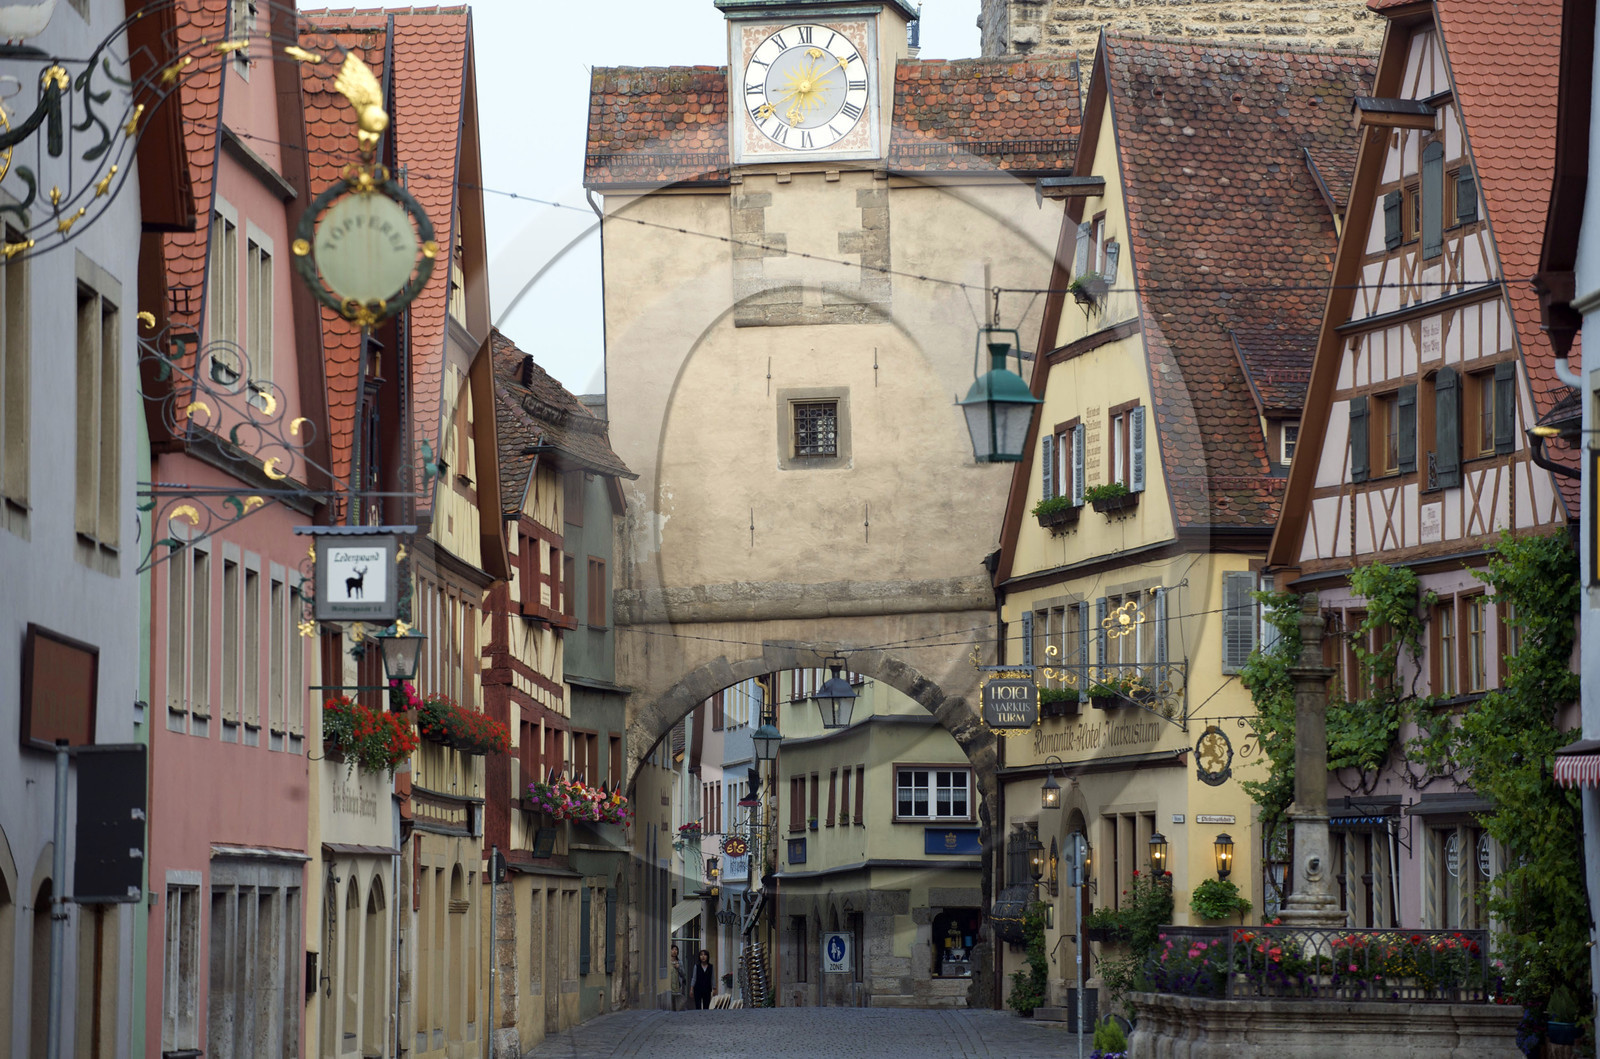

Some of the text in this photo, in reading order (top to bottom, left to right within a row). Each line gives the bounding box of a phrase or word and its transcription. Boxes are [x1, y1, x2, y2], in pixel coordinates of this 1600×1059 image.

[991, 686, 1029, 700] HOTEL
[991, 702, 1031, 712] MARKUS
[997, 713, 1025, 722] TURM
[1102, 718, 1160, 750] Markusturm
[829, 963, 844, 971] ZONE
